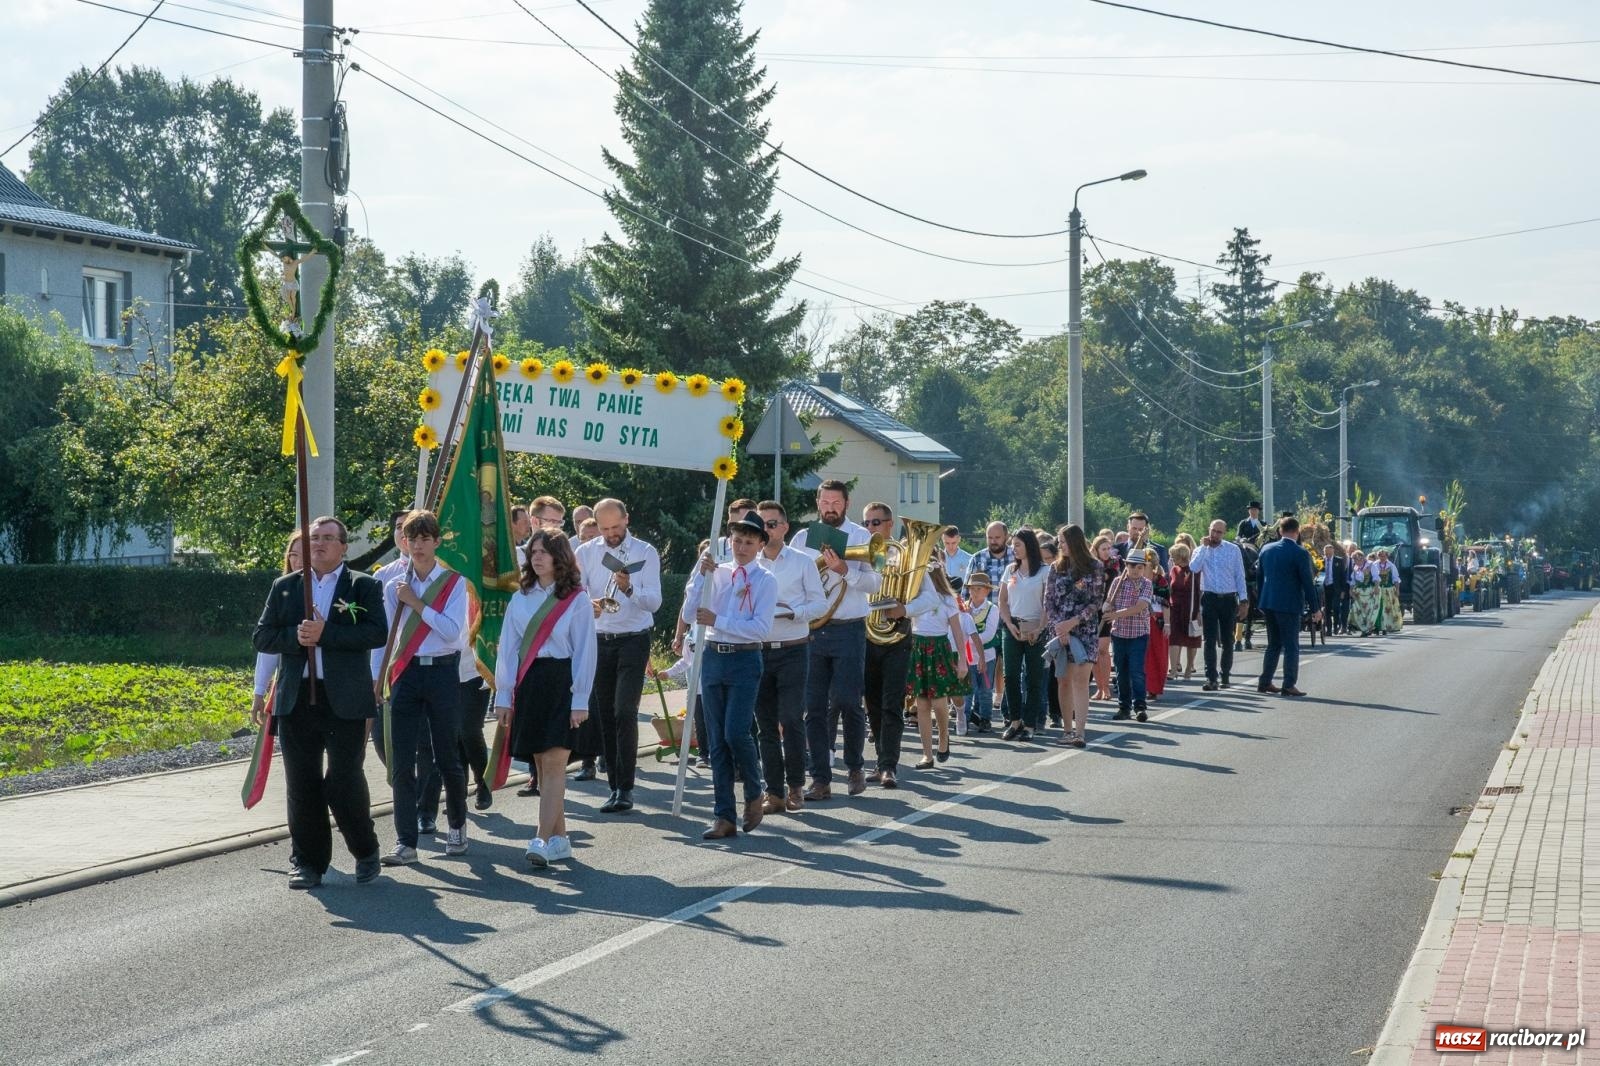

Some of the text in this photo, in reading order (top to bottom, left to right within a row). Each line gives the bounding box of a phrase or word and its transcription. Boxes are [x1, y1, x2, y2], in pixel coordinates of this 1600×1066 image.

[549, 387, 581, 409] TWA
[536, 416, 567, 438] NAS
[584, 421, 604, 443] DO
[619, 425, 658, 449] SYTA
